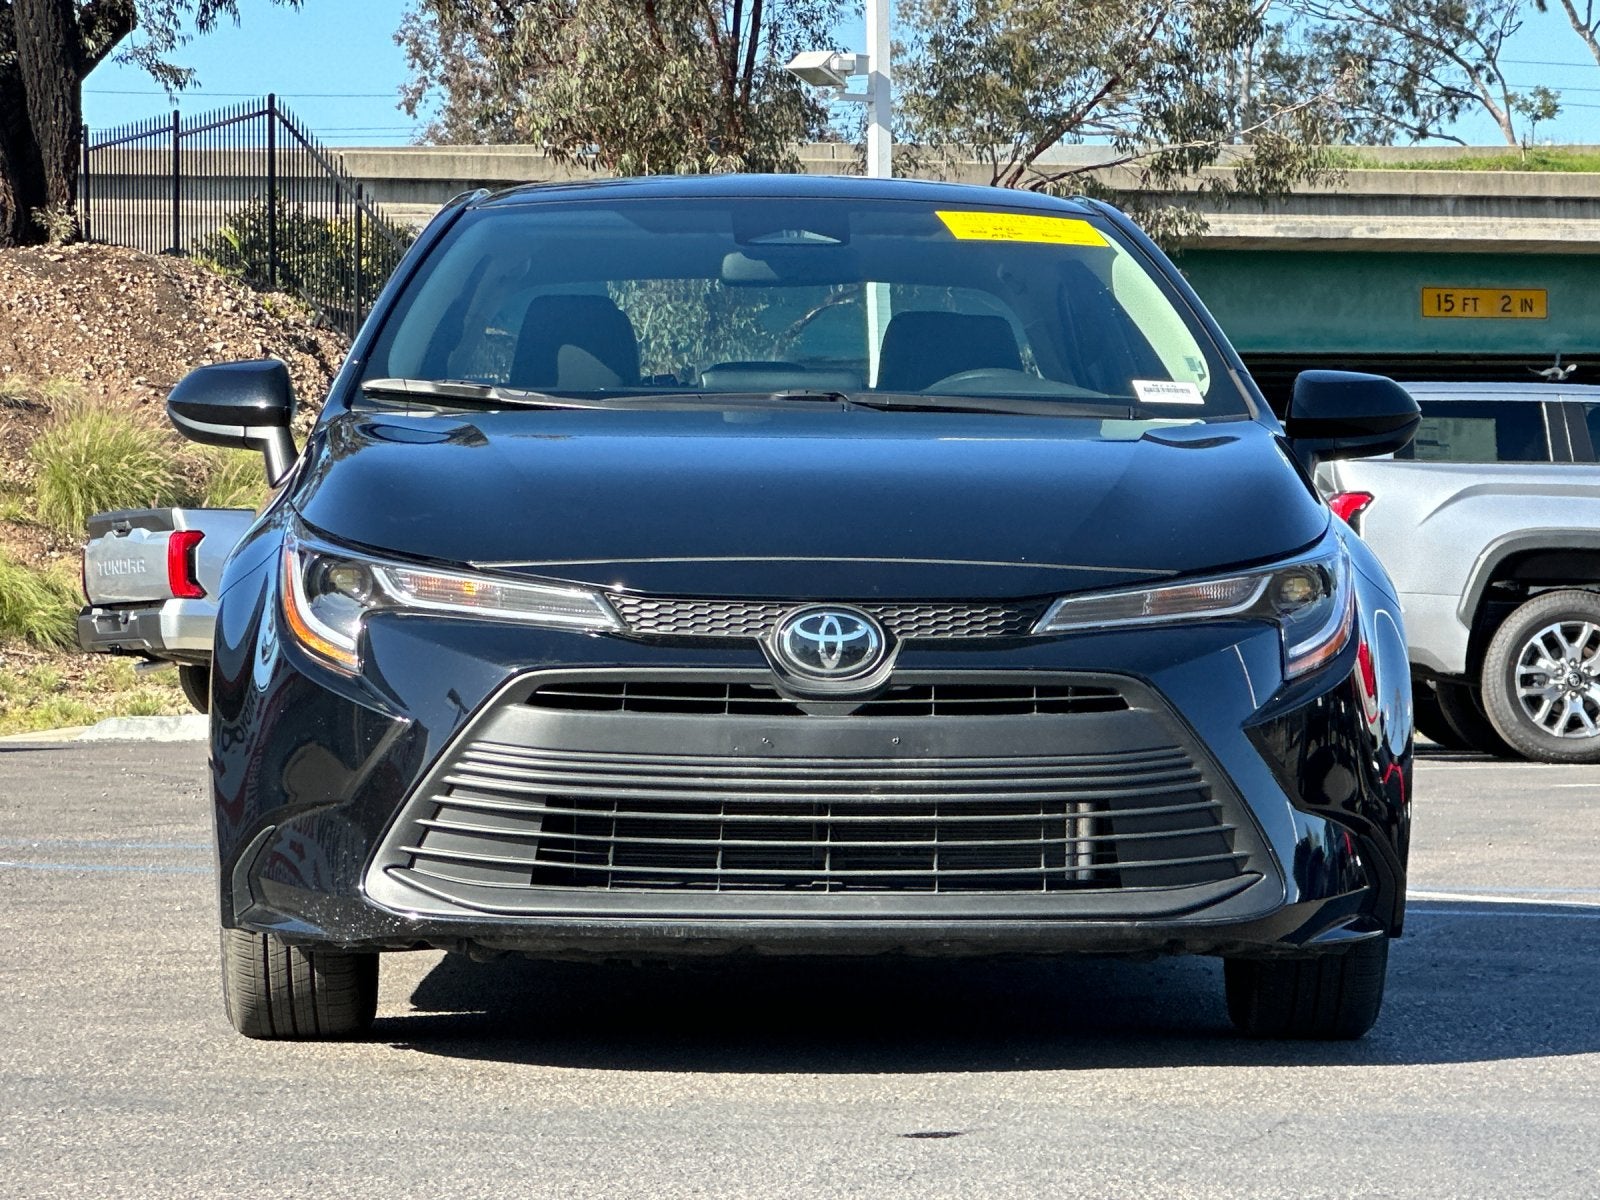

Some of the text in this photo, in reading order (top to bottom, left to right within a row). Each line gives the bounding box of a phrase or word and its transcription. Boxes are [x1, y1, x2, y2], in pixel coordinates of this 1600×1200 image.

[1437, 294, 1534, 313] 15 FT 2 IN
[97, 558, 146, 576] TUNDRA
